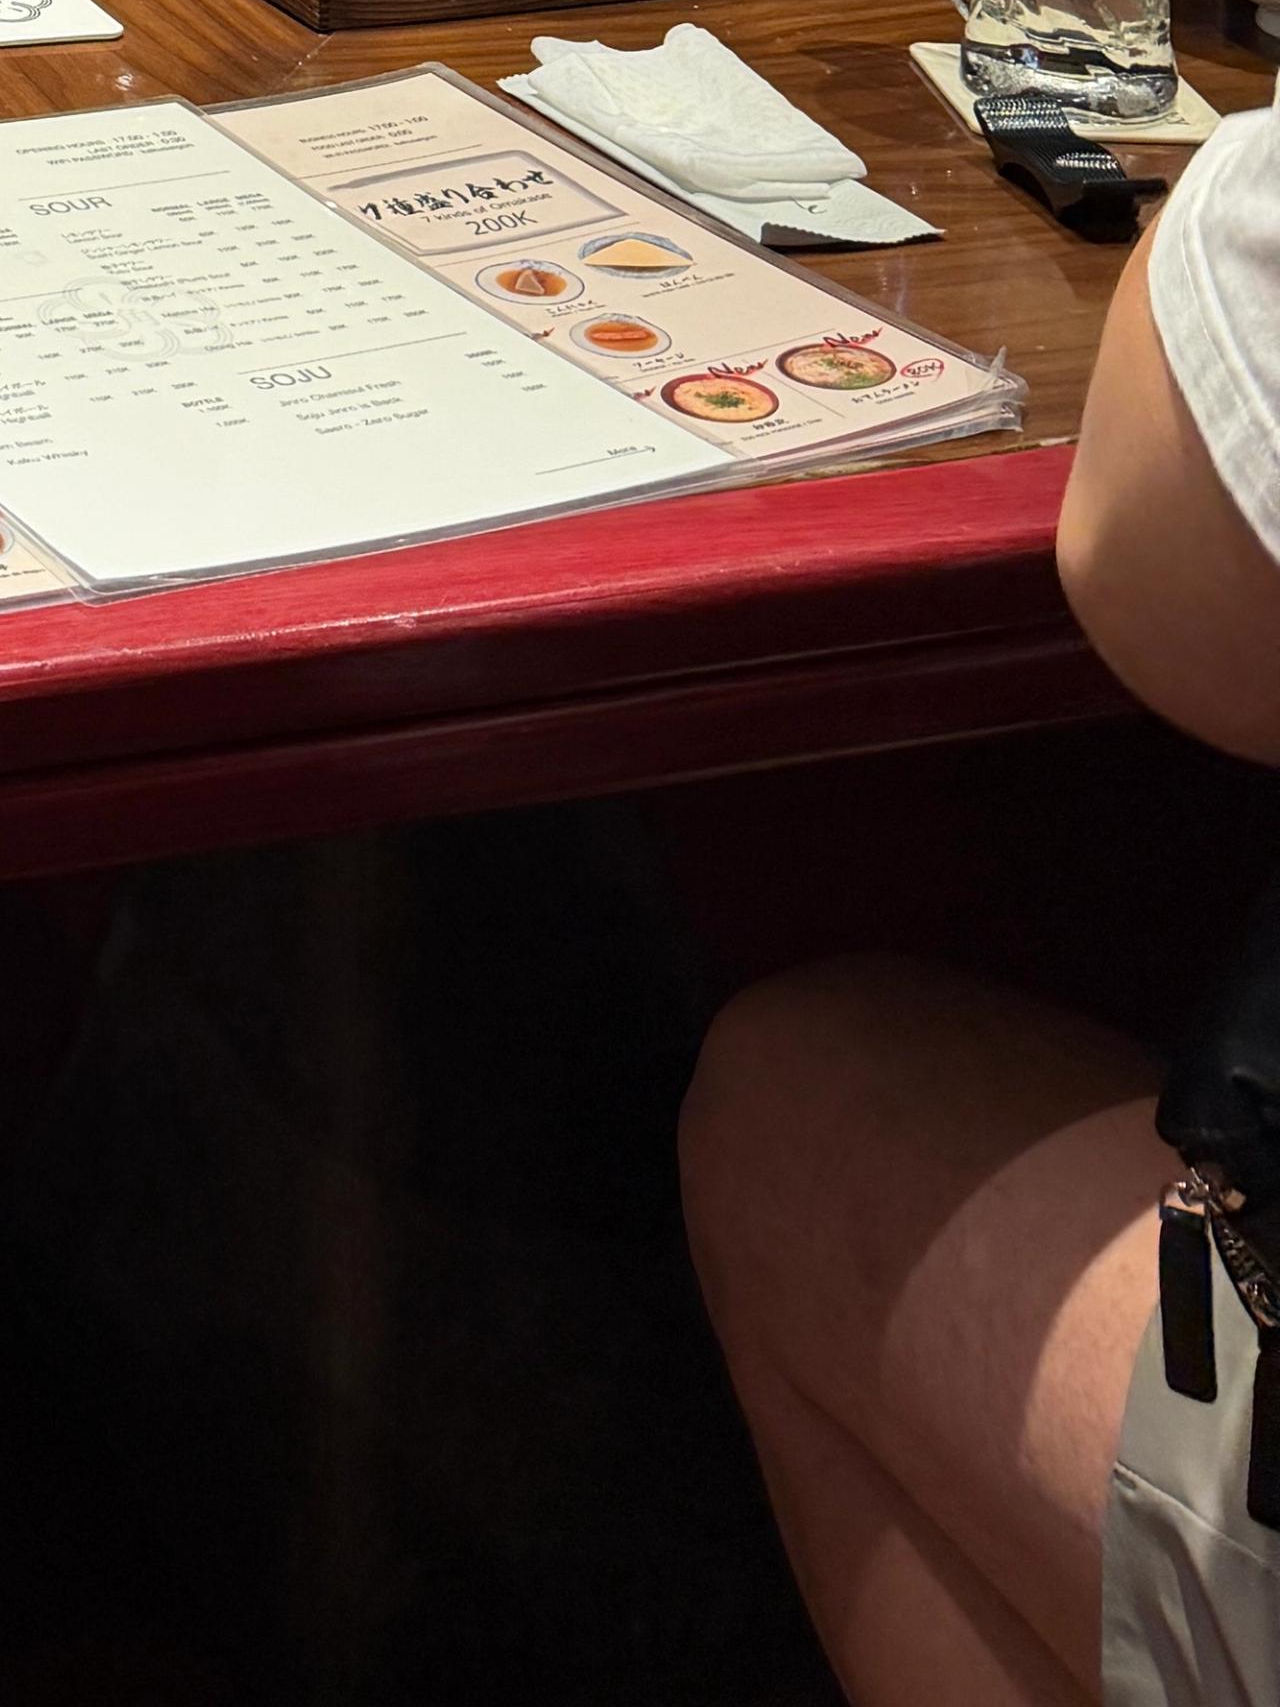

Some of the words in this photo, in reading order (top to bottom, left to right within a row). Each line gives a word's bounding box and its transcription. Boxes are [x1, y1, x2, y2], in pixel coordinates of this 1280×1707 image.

[28, 195, 114, 219] SOUR
[466, 209, 540, 236] 200K
[248, 364, 334, 391] SOJU
